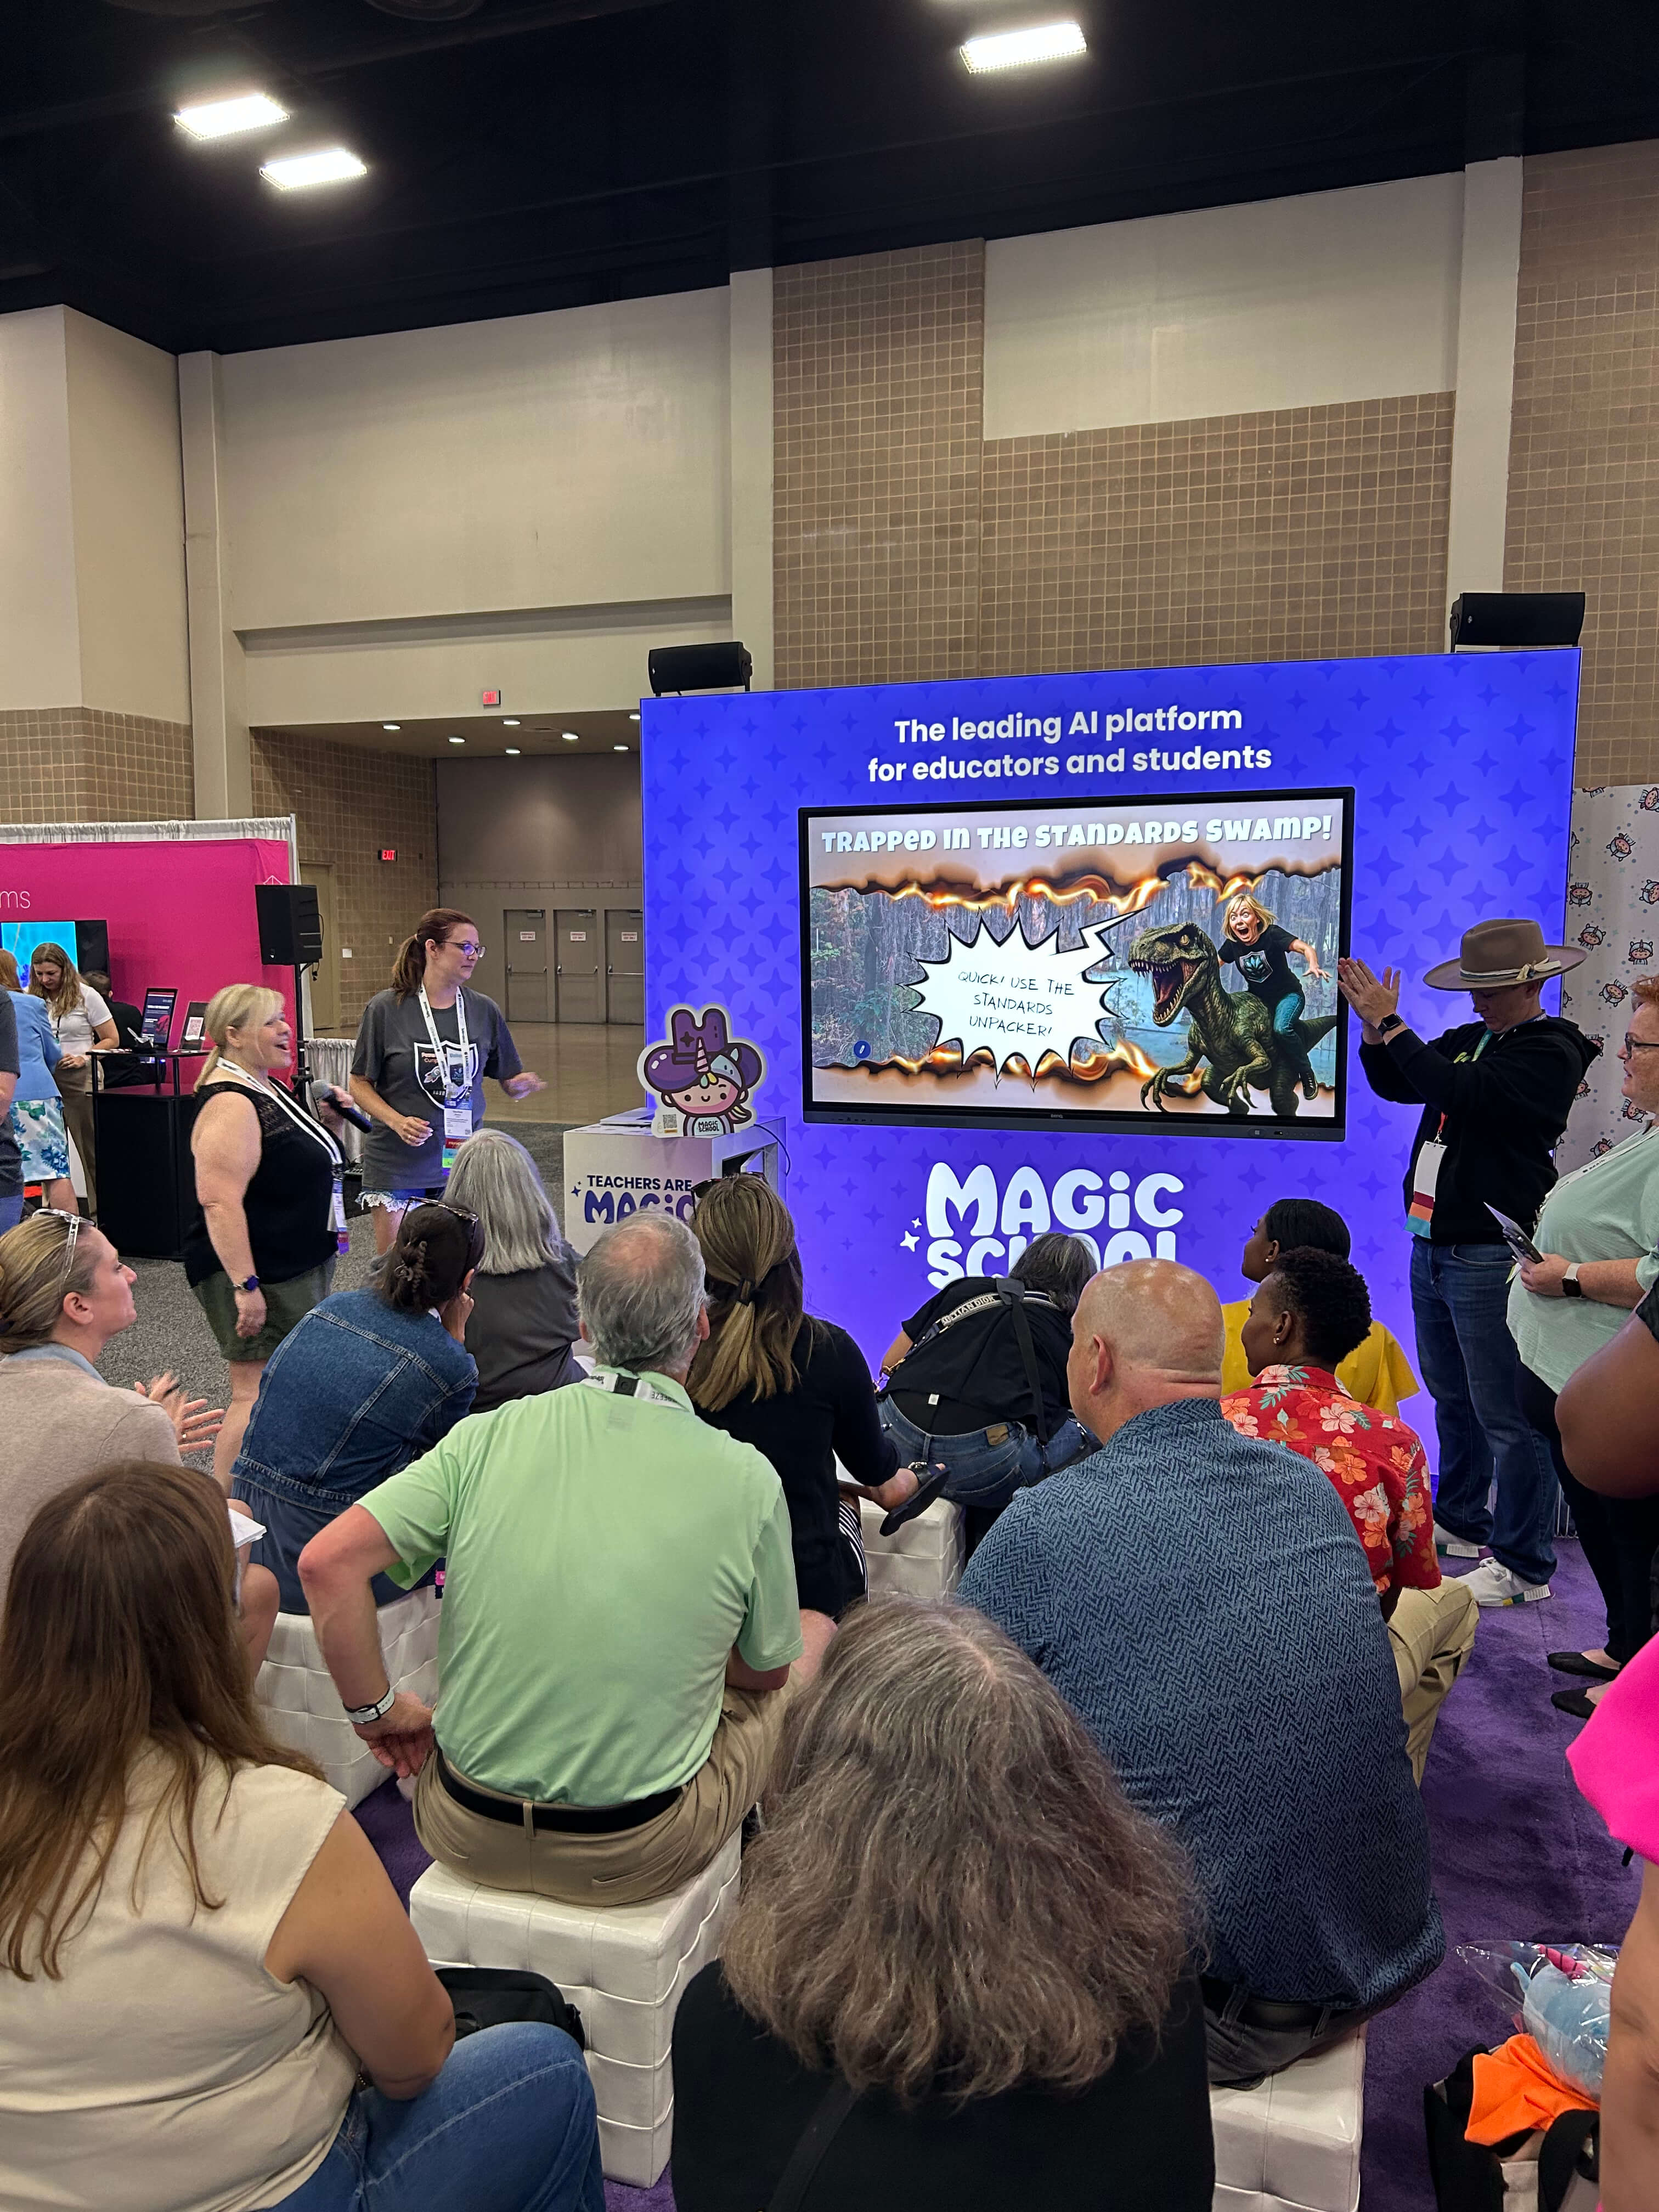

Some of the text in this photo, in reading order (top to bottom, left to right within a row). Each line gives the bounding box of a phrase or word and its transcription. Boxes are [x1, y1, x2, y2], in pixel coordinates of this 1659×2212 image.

[894, 706, 1242, 744] The leading AI platform
[868, 746, 1272, 782] for educators and students
[382, 850, 396, 860] EXIT
[958, 971, 1075, 995] QUICK! USE THE
[973, 992, 1053, 1015] STANDARDS
[969, 1015, 1052, 1036] UNPACKER!
[587, 1175, 692, 1192] TEACHERS ARE
